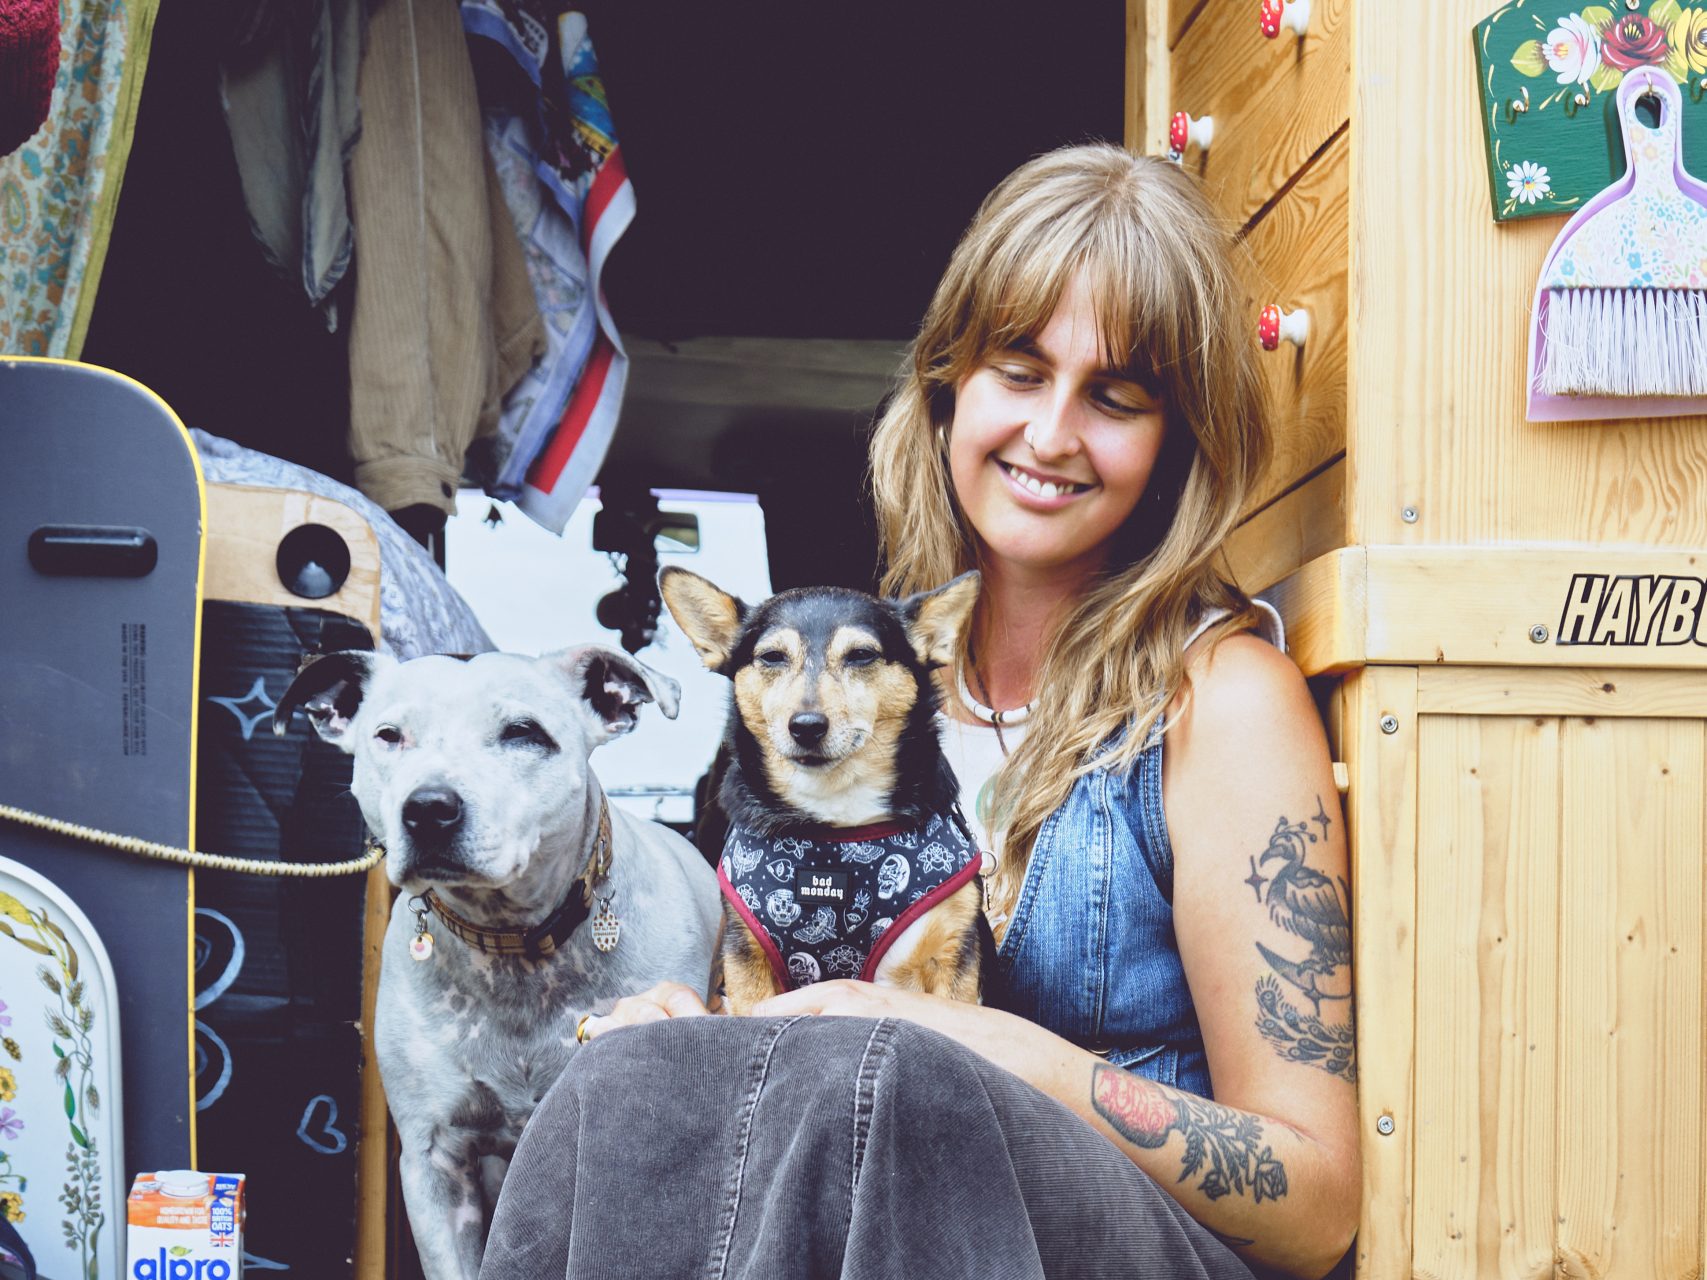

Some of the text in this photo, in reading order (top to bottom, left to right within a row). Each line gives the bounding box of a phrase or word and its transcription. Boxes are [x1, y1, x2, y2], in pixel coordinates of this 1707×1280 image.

[812, 875, 832, 886] bad
[801, 886, 844, 900] monday
[211, 1207, 232, 1215] 100%
[211, 1222, 232, 1231] OATS
